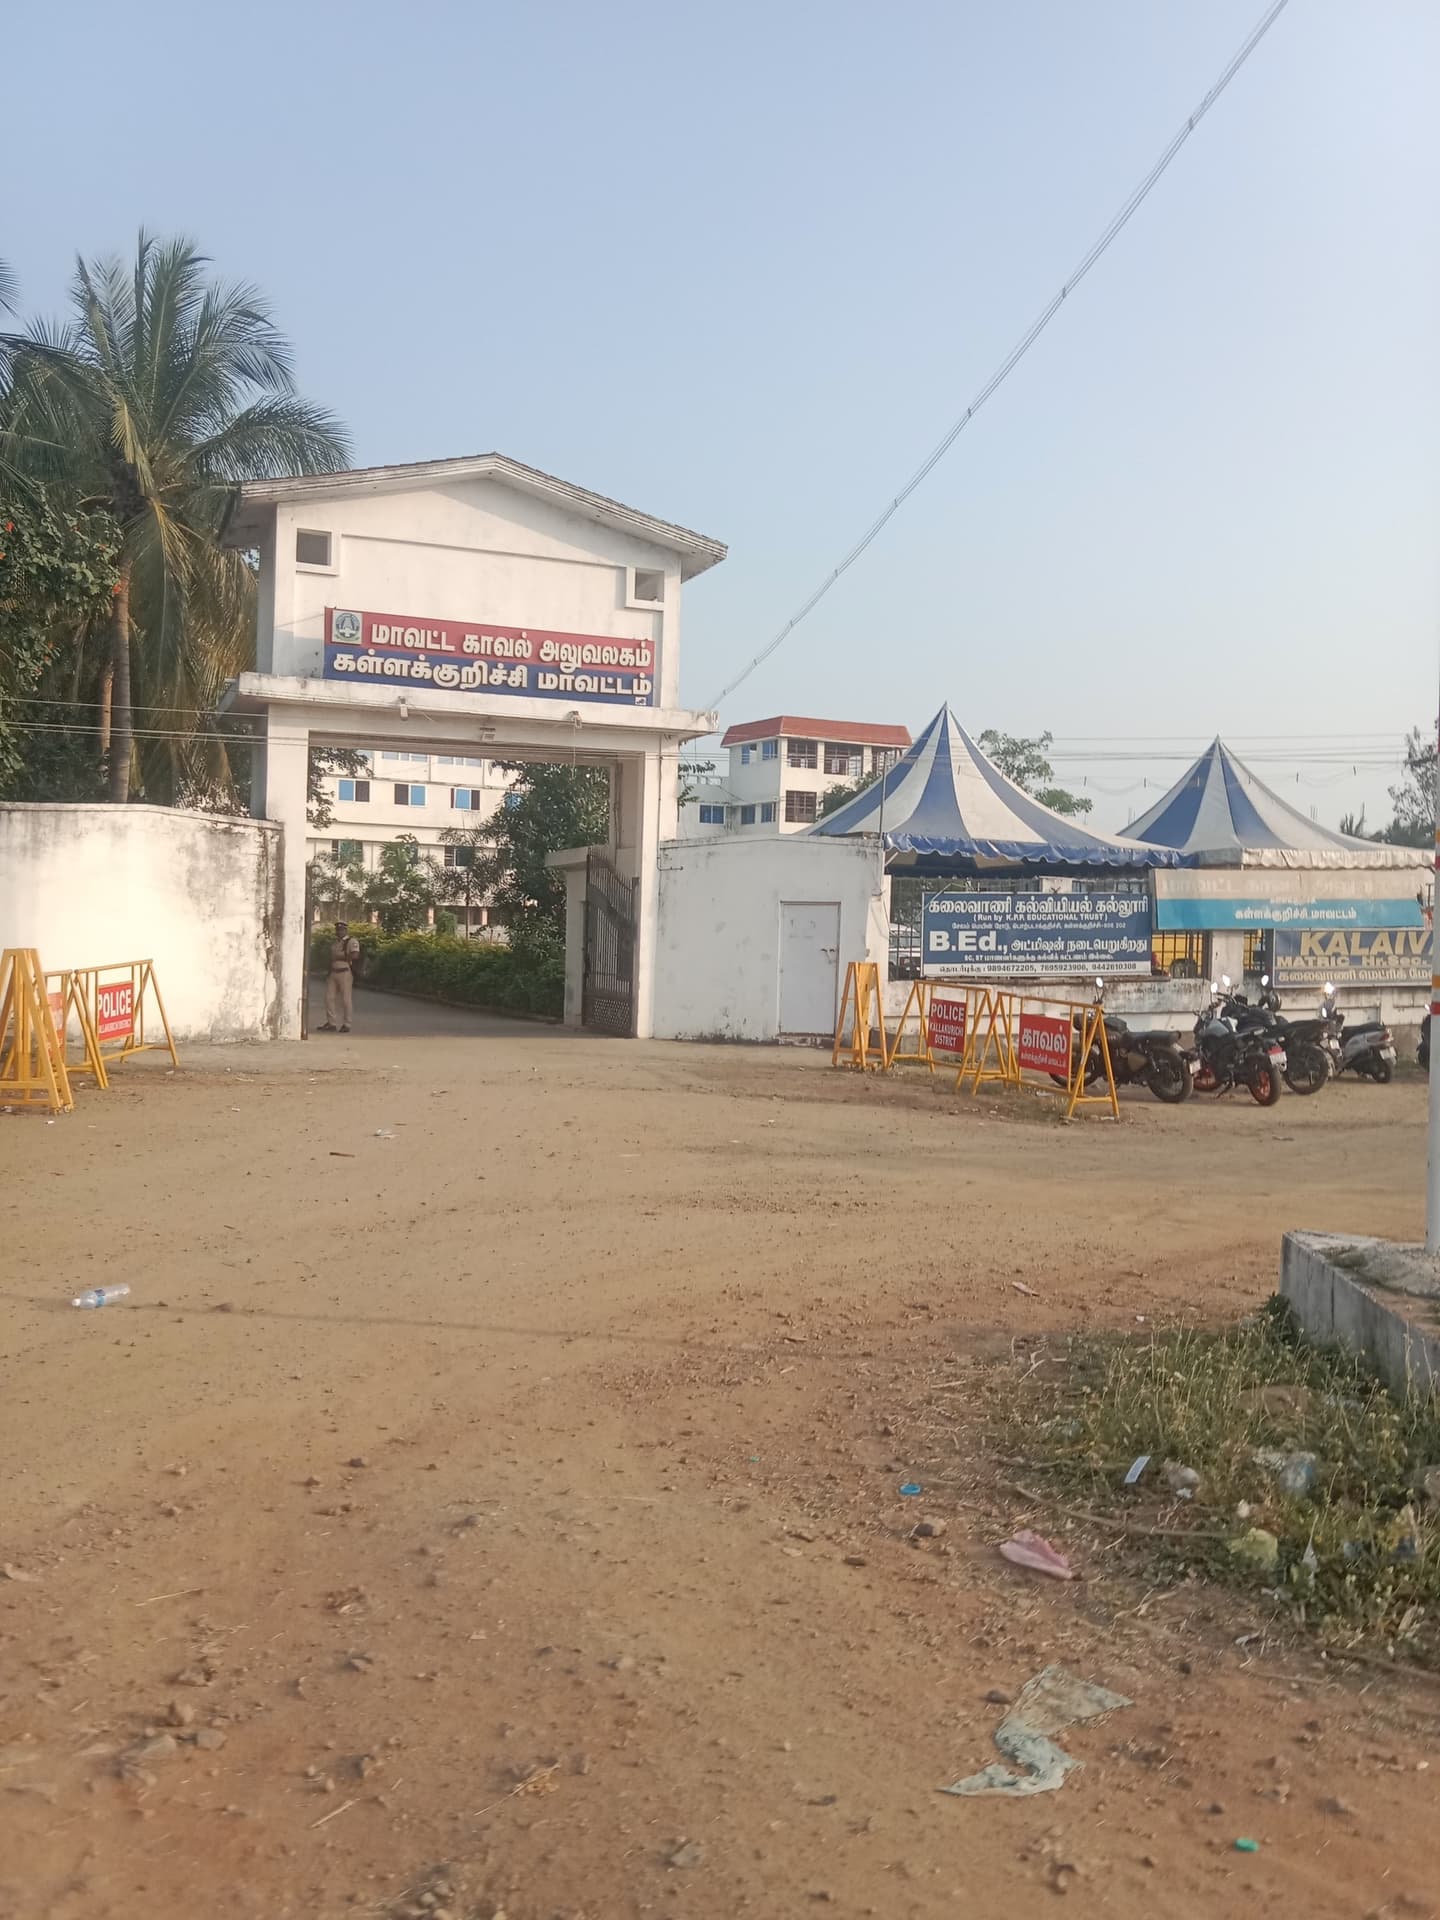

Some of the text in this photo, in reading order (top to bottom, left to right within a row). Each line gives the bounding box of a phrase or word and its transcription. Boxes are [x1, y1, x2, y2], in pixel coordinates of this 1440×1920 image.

[371, 623, 653, 672] மாவட்ட காவல் அலுவலகம்
[333, 649, 653, 697] கள்ளக்குறிச்சி மாவட்டம்
[929, 895, 1149, 918] கலைவாணி கல்வியியல் கல்லூரி
[994, 914, 1003, 922] by
[929, 930, 1148, 954] B.Ed., அட்மிஷன் நடைபெறுகிறது
[1300, 931, 1434, 956] KALAIV
[1277, 956, 1350, 968] MATRIC
[1279, 969, 1356, 982] கலைவாணி
[98, 989, 132, 1018] POLICE
[931, 1003, 965, 1022] POLICE
[1022, 1025, 1068, 1055] காவல்
